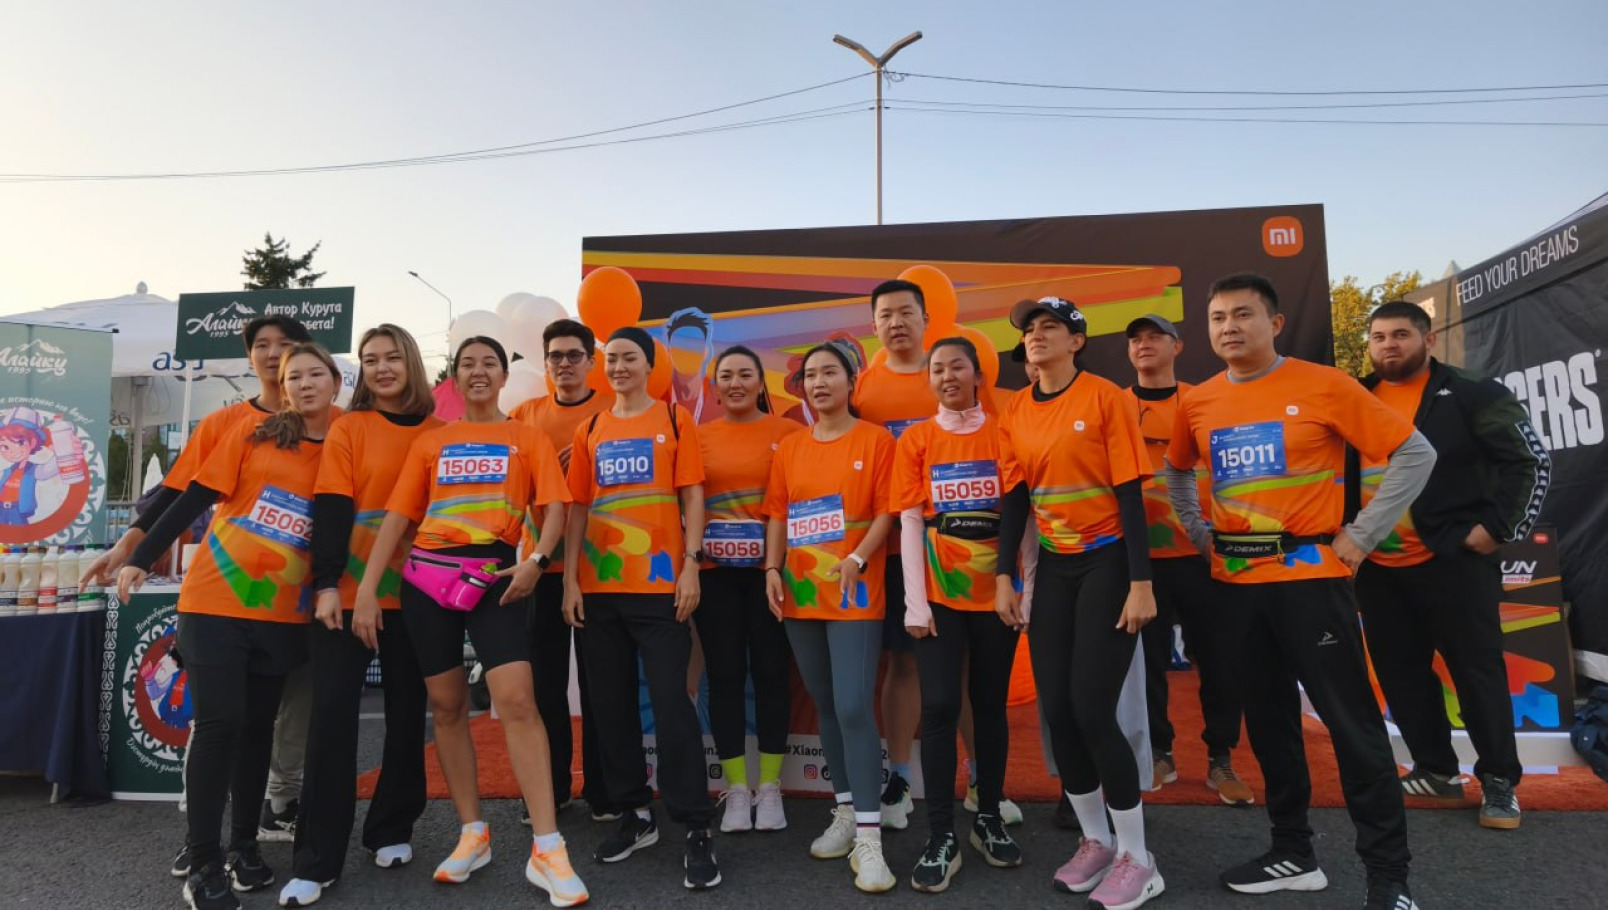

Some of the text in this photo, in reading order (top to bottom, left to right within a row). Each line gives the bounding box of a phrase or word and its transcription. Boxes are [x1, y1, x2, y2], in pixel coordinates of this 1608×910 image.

[1456, 225, 1579, 306] FEED YOUR DREAMS
[264, 300, 343, 319] Автор Курута
[598, 455, 649, 477] 15010
[1218, 443, 1275, 468] 15011
[443, 458, 504, 476] 15063
[935, 480, 996, 501] 15059
[791, 513, 842, 538] 15056
[705, 541, 761, 559] 15058
[1234, 545, 1272, 553] DEMIX
